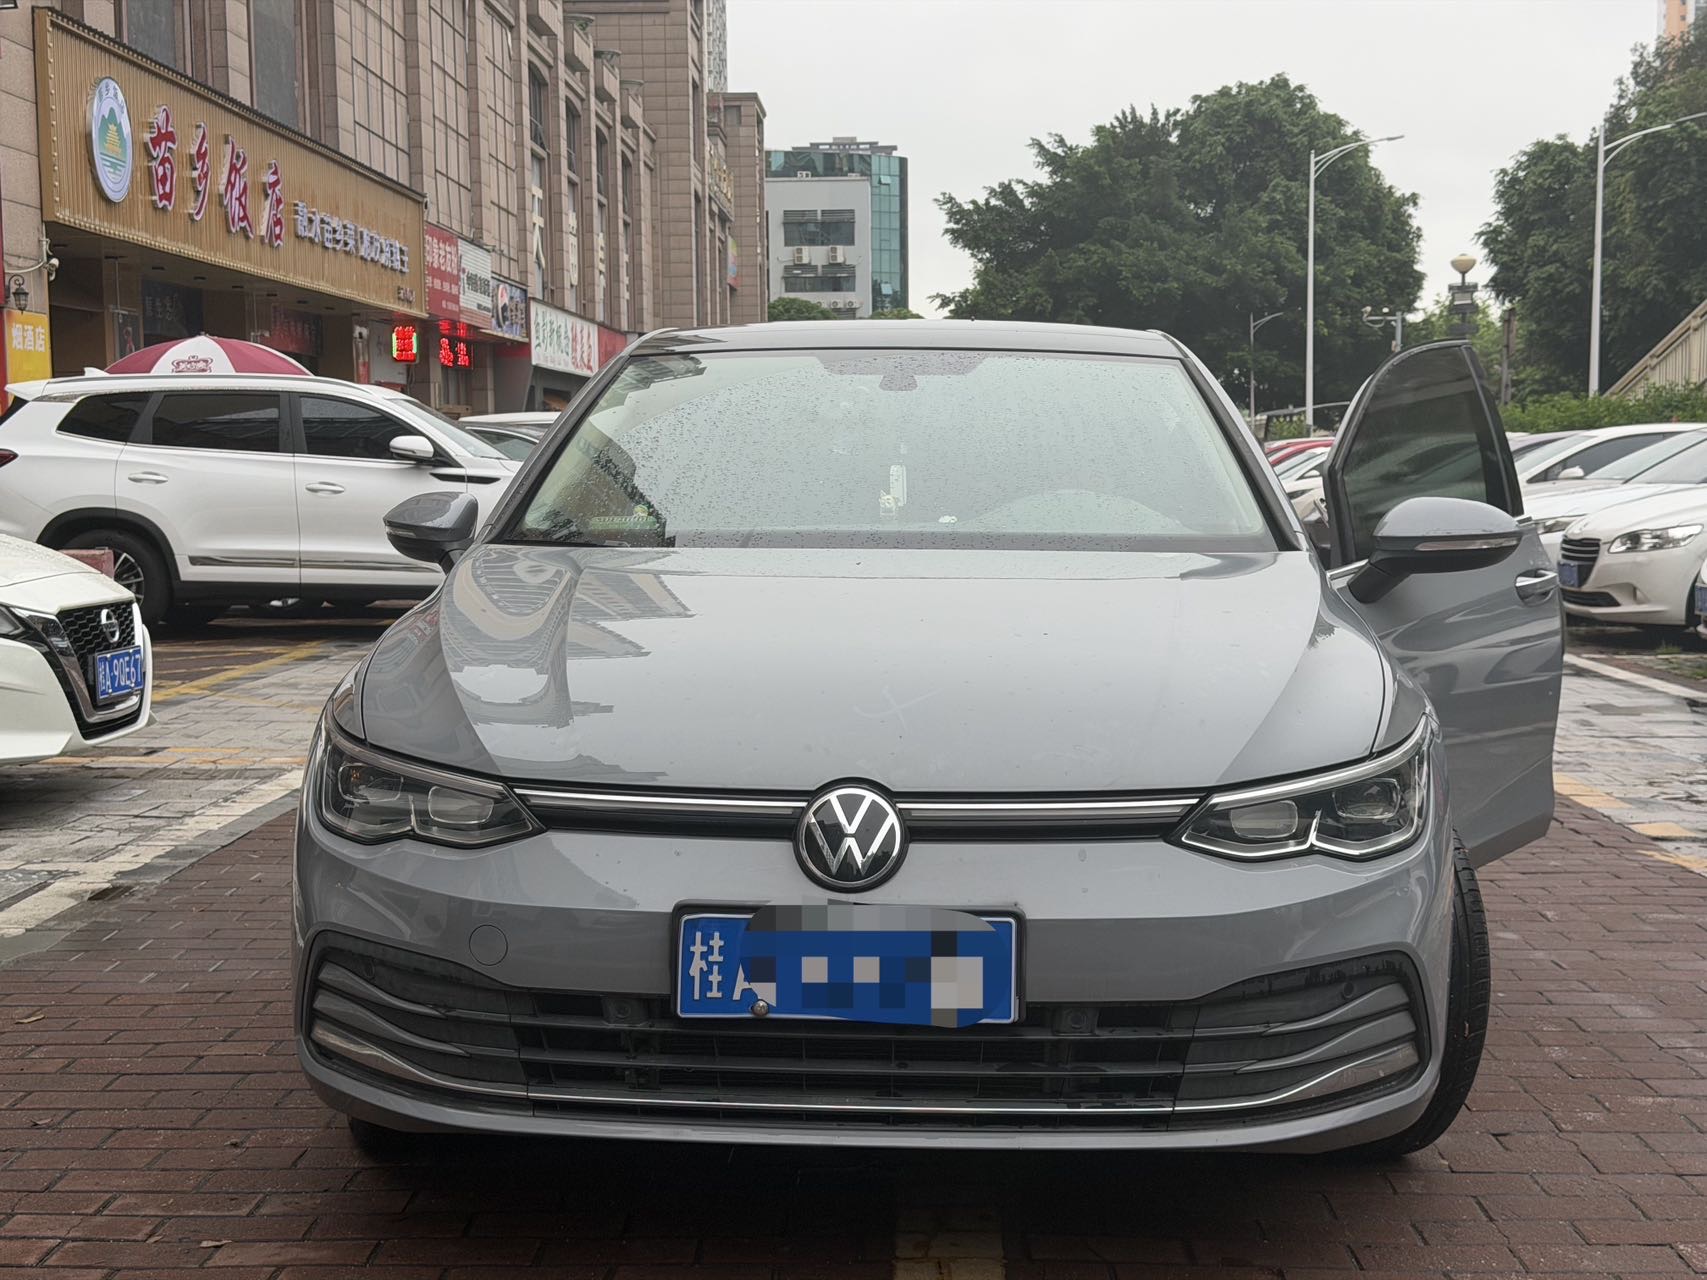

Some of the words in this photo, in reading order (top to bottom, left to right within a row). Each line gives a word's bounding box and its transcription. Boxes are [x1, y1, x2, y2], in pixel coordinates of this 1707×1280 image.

[149, 104, 285, 249] 苗乡饭店
[11, 322, 46, 353] 烟酒店
